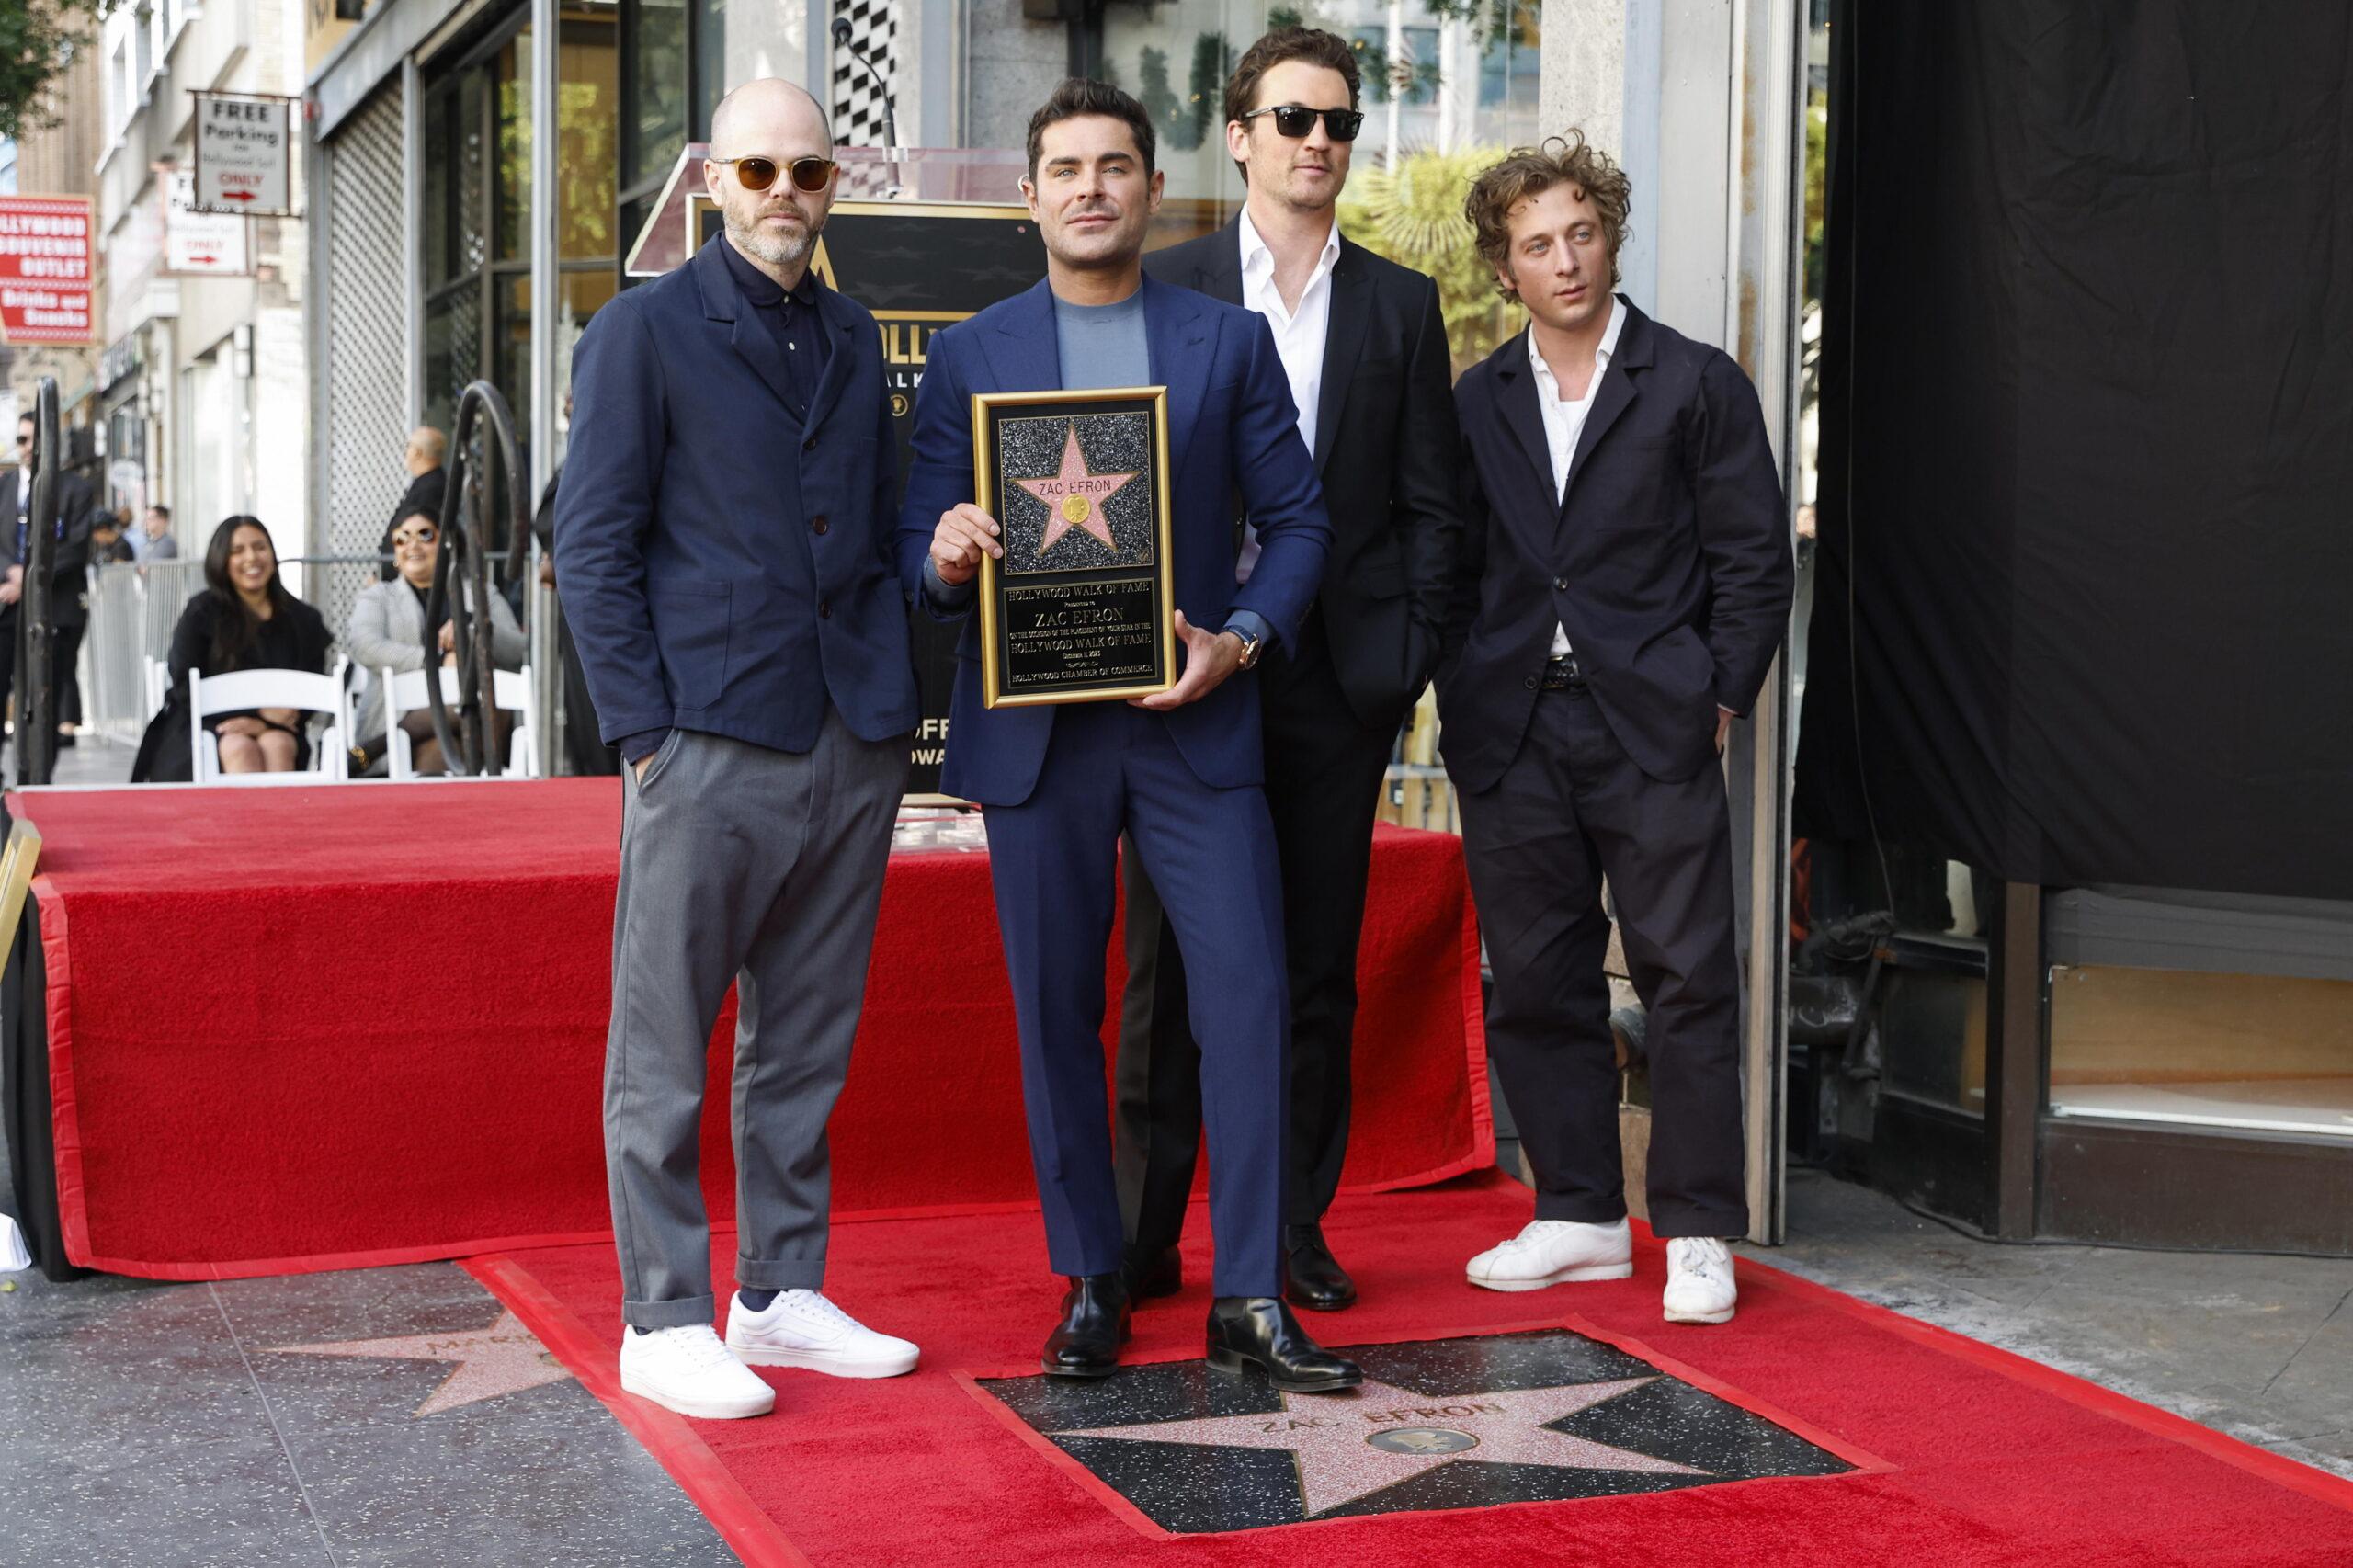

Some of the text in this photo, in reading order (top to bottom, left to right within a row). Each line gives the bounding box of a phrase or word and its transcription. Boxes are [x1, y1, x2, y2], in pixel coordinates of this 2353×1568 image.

[212, 102, 269, 122] FREE
[204, 123, 278, 148] Parking
[219, 172, 264, 187] ONLY
[20, 256, 87, 278] OUTLET
[2, 289, 88, 309] Drinks and
[24, 309, 88, 327] Snacks
[1039, 480, 1111, 495] ZAC EFRON
[1009, 582, 1149, 601] HOLLYWOOD WALK OF FAME
[1035, 608, 1124, 627] ZAC EFRON
[1060, 628, 1069, 636] THE
[1070, 626, 1097, 635] PLACEMENT
[1011, 633, 1151, 653] HOLLYWOOD WALK OF FAME
[1012, 665, 1153, 683] HOLLYWOOD CHAMBER OF COMMERCE
[1253, 1403, 1506, 1433] ZAC EFRON
